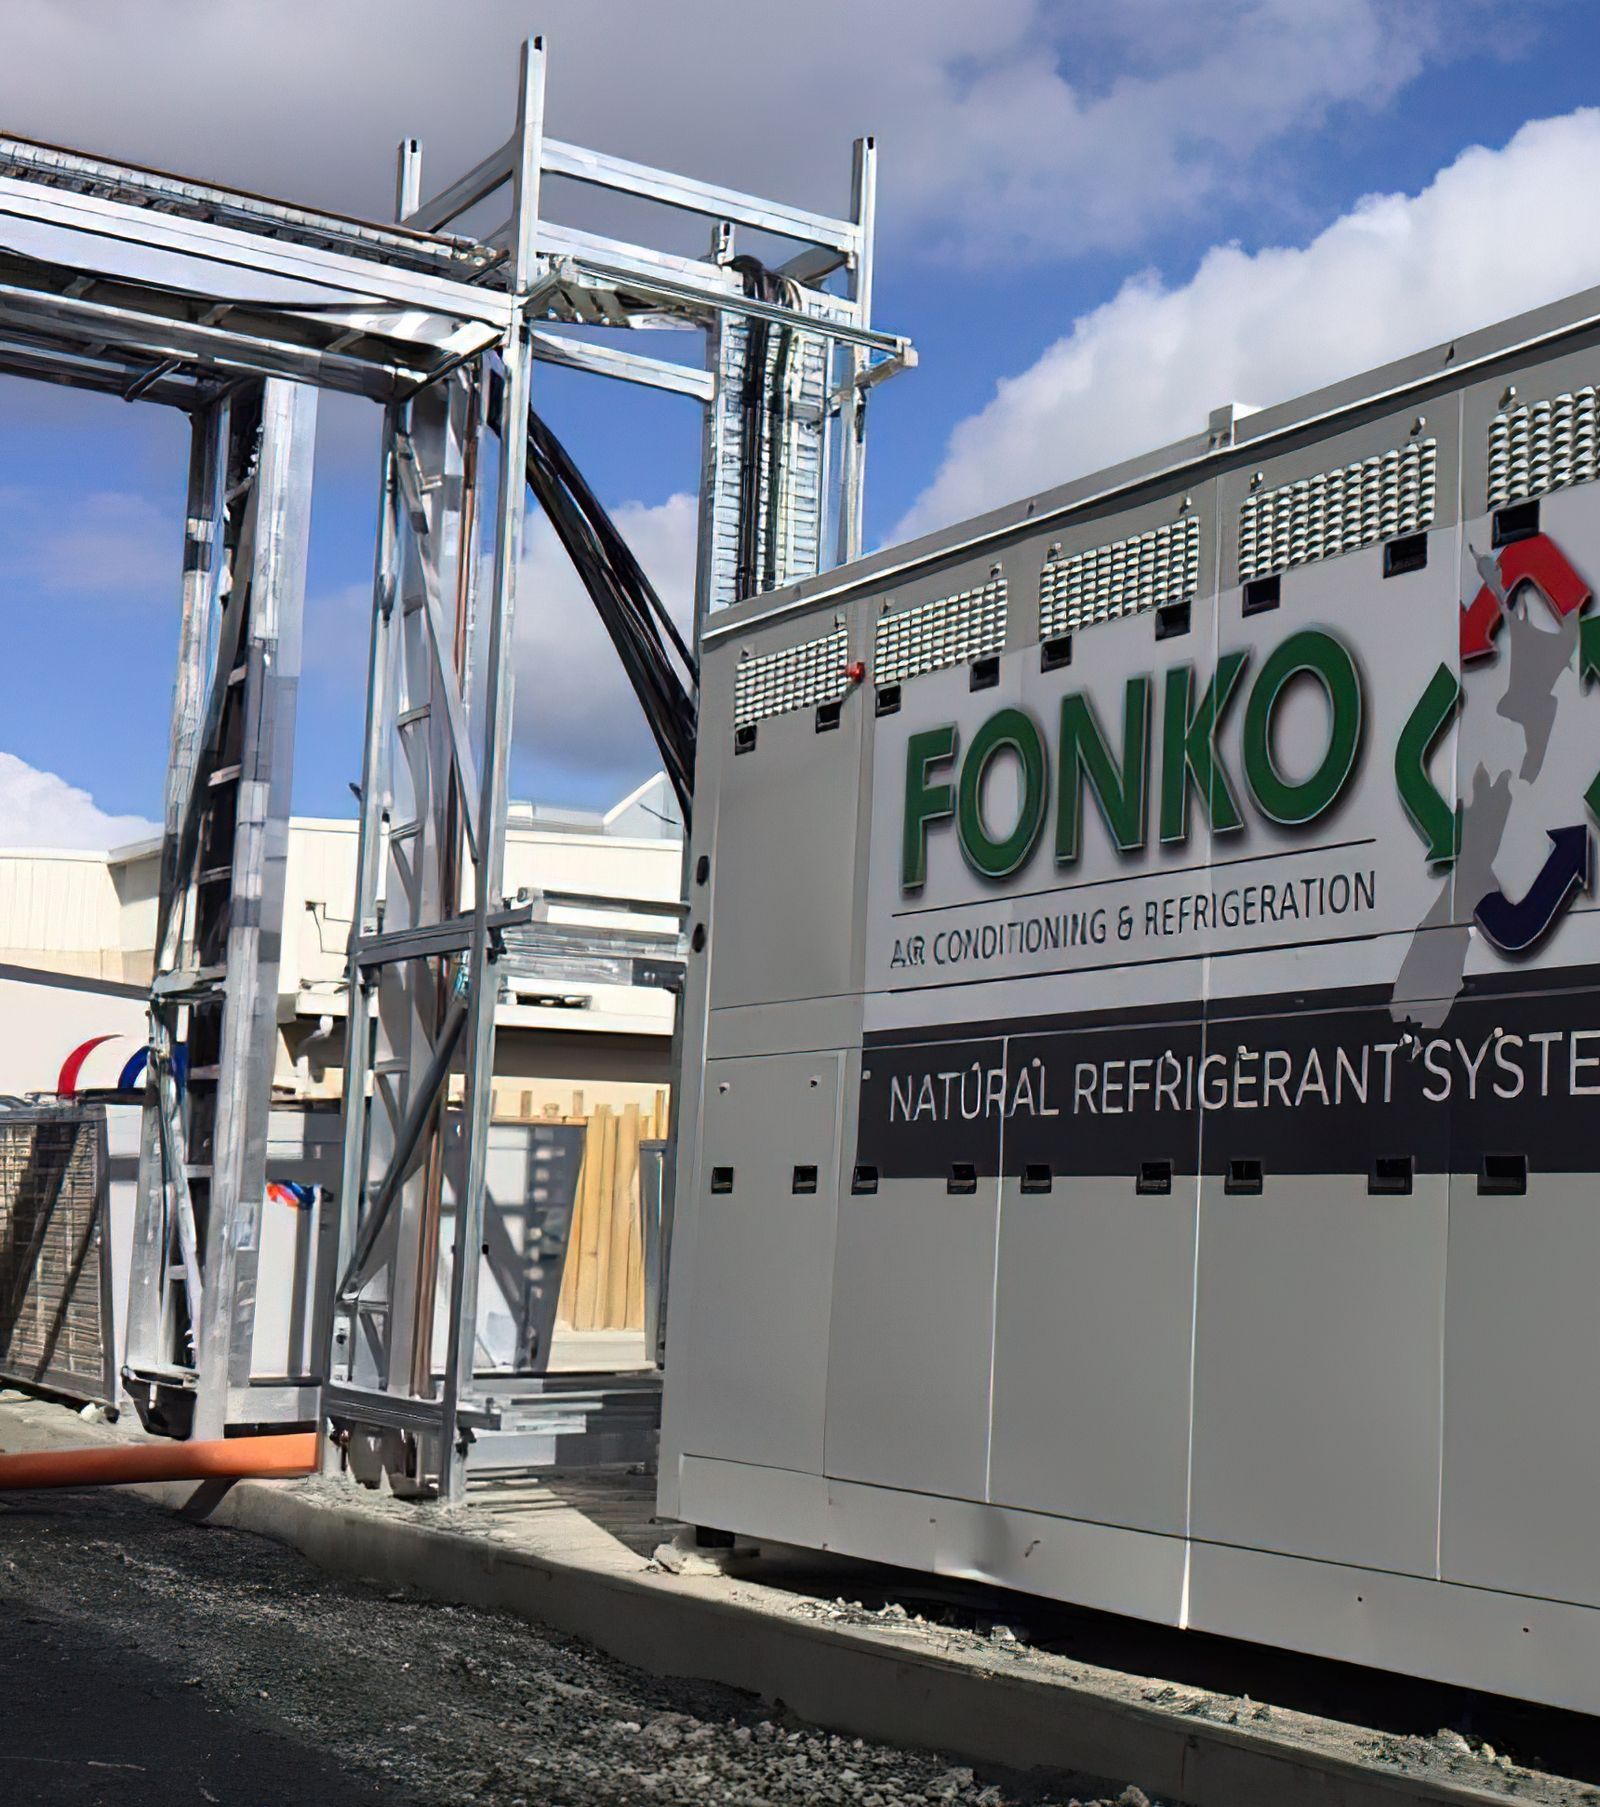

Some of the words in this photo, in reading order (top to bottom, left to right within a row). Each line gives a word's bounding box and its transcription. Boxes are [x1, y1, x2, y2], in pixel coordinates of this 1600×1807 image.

[901, 629, 1363, 890] FONKO
[889, 936, 926, 969] AIR
[933, 909, 1107, 963] CONDITIONING
[1117, 906, 1134, 941] &
[1145, 870, 1376, 936] REFRIGERATION
[889, 1060, 1060, 1123] NATURAL
[1073, 1043, 1400, 1115] REFRIGERANT
